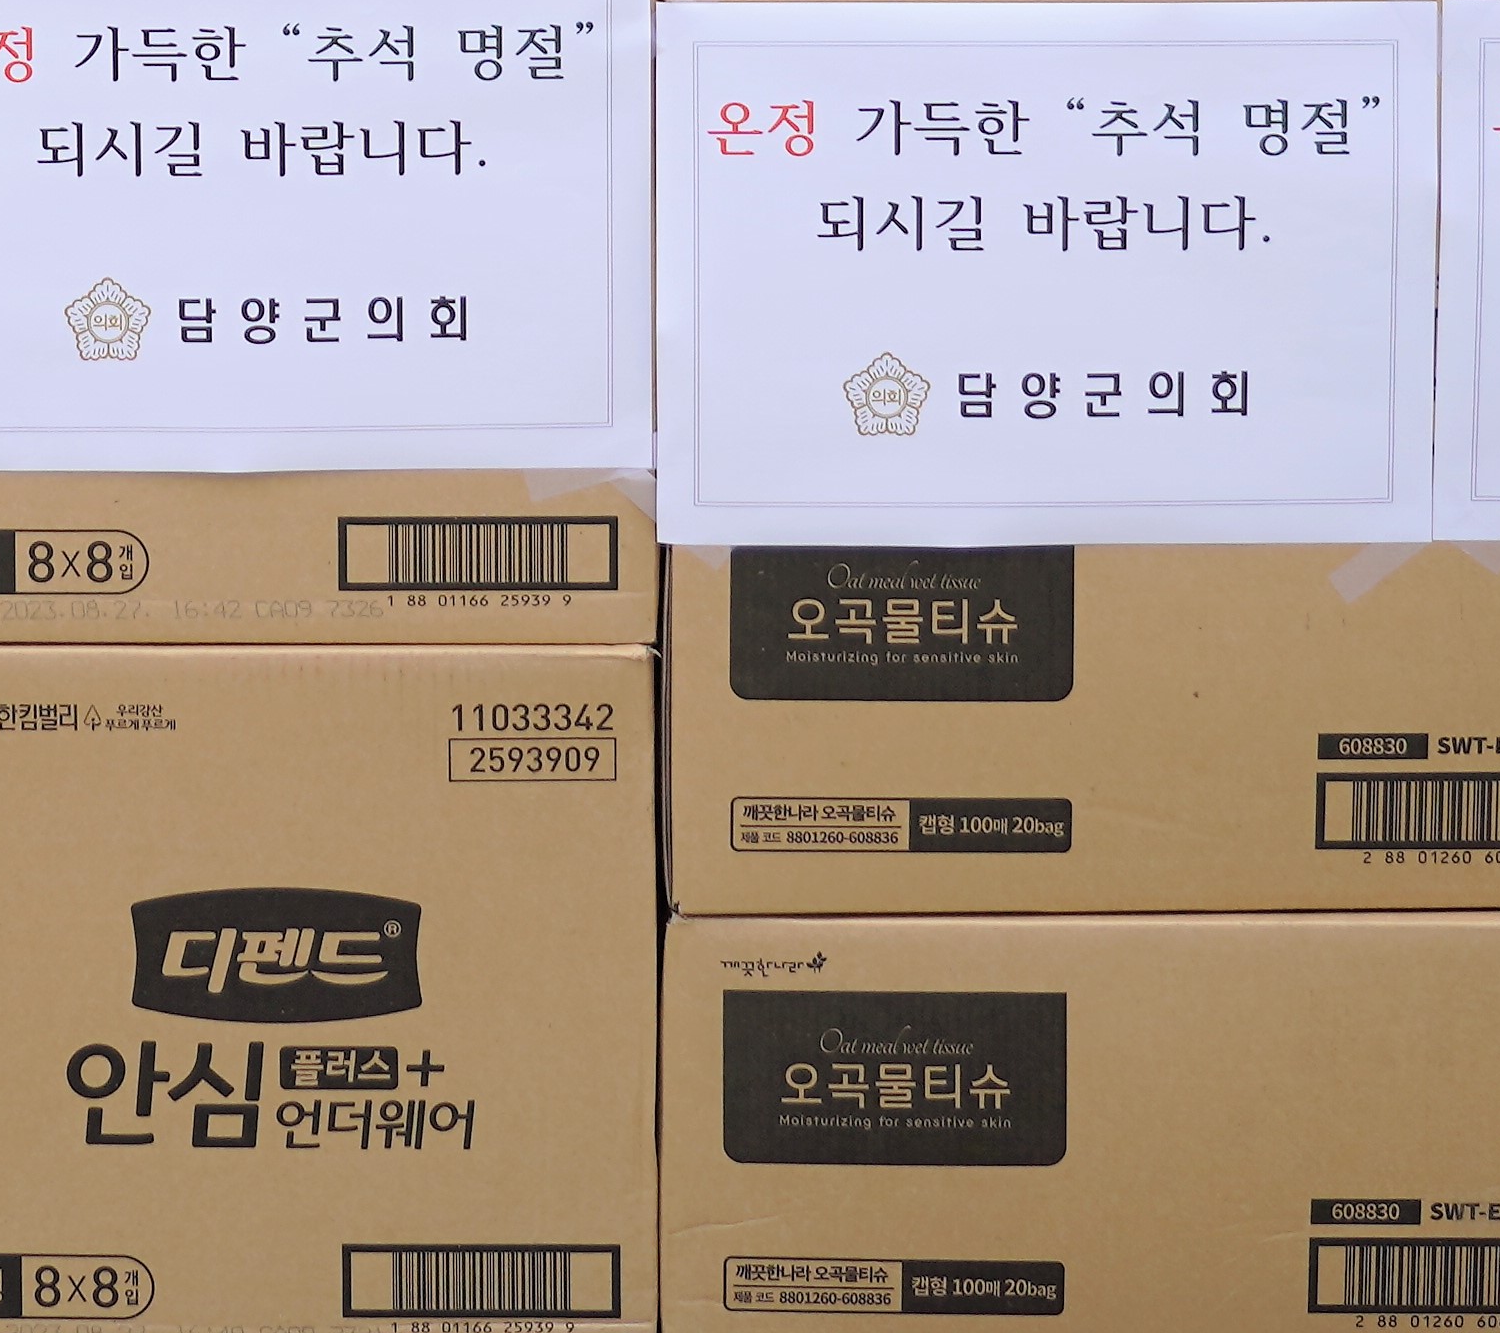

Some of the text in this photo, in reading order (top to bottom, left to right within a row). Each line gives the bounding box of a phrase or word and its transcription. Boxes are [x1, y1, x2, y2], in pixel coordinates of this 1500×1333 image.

[75, 26, 246, 82] 가득한
[708, 100, 813, 156] 온정
[857, 100, 1029, 156] 가득한
[37, 120, 485, 177] 되시길 바랍니다.
[817, 196, 1270, 251] 되시길 바랍니다.
[787, 598, 1017, 644] 오곡물티슈
[785, 650, 1019, 666] Moisturizing for sensitive skin
[453, 704, 613, 731] 11033342
[471, 747, 599, 772] 2593909
[1338, 737, 1407, 754] 608830
[742, 802, 896, 824] 깨끗한나라 오곡물티슈
[919, 814, 1064, 837] 캡형 100매 20bag
[67, 1041, 264, 1148] 안심
[781, 1064, 1010, 1109] 오곡물티슈
[277, 1100, 475, 1149] 언더웨어
[1331, 1204, 1399, 1221] 608830
[735, 1262, 889, 1284] 깨끗한나라 오곡물티슈
